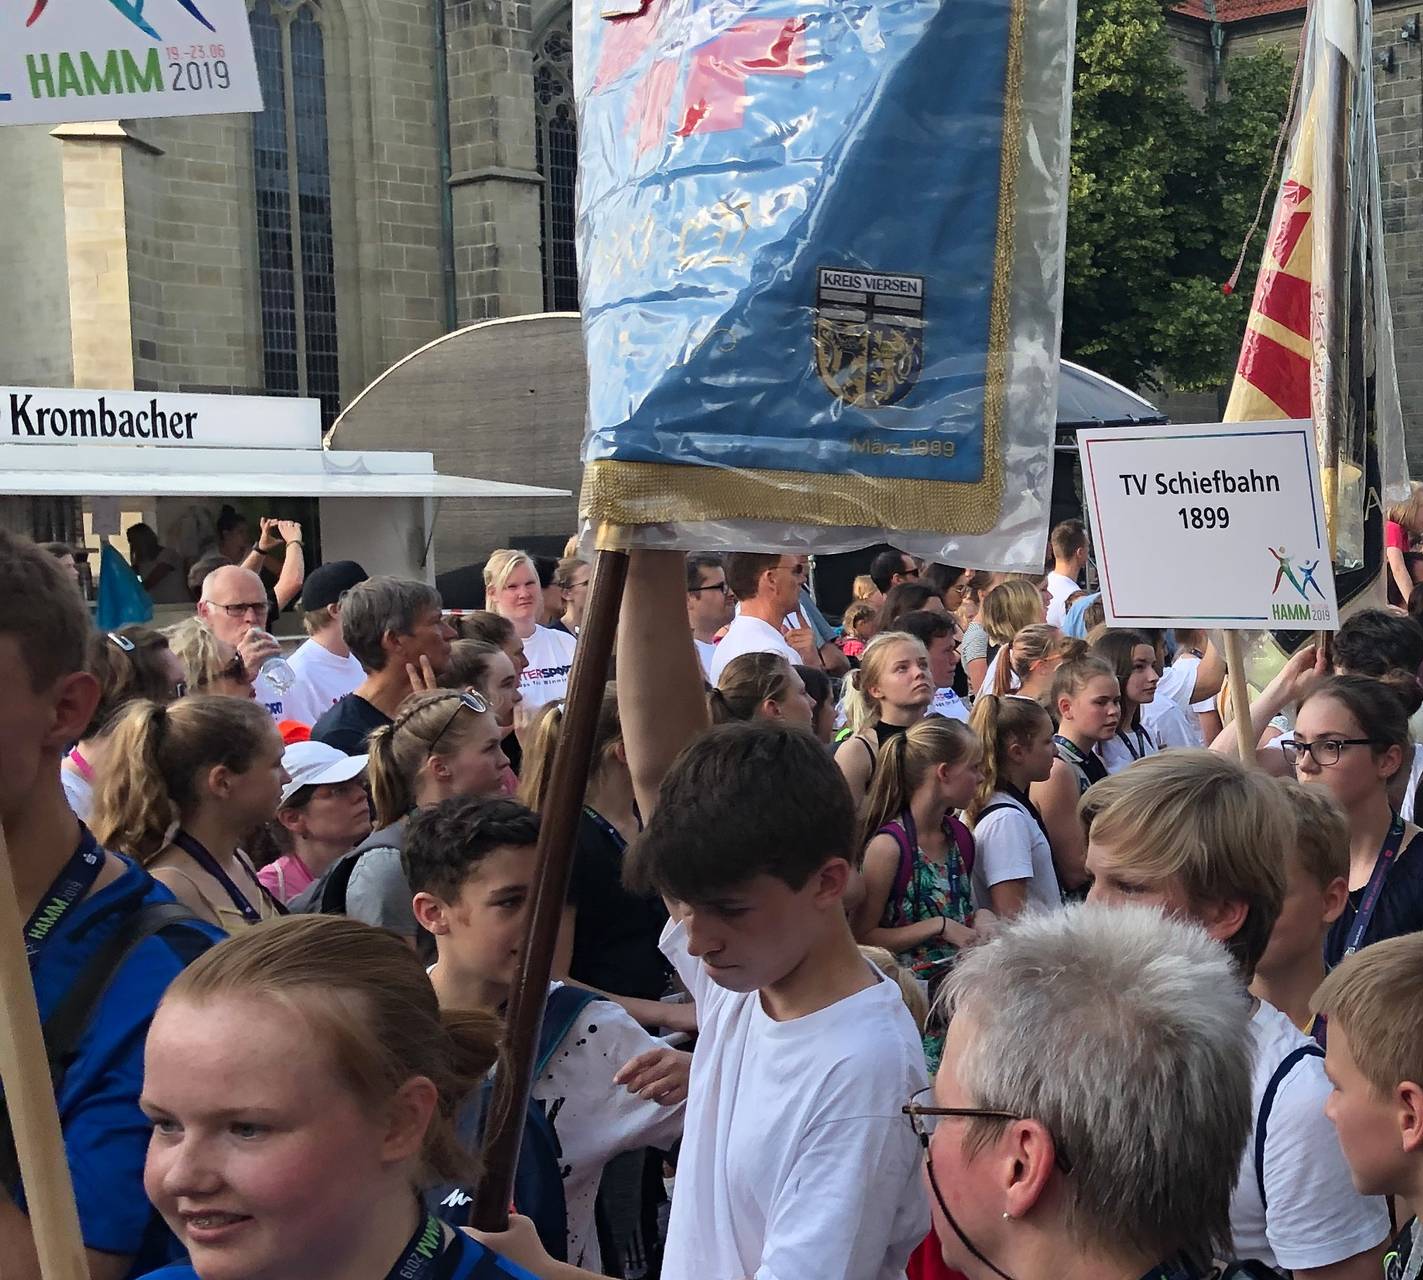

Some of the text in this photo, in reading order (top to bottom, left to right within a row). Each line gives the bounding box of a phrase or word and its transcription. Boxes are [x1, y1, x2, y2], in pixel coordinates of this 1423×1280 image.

[26, 48, 231, 98] HAMM 2019
[824, 273, 918, 293] KREIS VIERSEN
[10, 393, 199, 439] Krombacher
[1119, 469, 1280, 495] TV Schiefbahn
[1178, 507, 1230, 529] 1899
[1272, 604, 1311, 620] HAMM
[1312, 609, 1331, 621] 2019
[29, 897, 70, 939] HAMM
